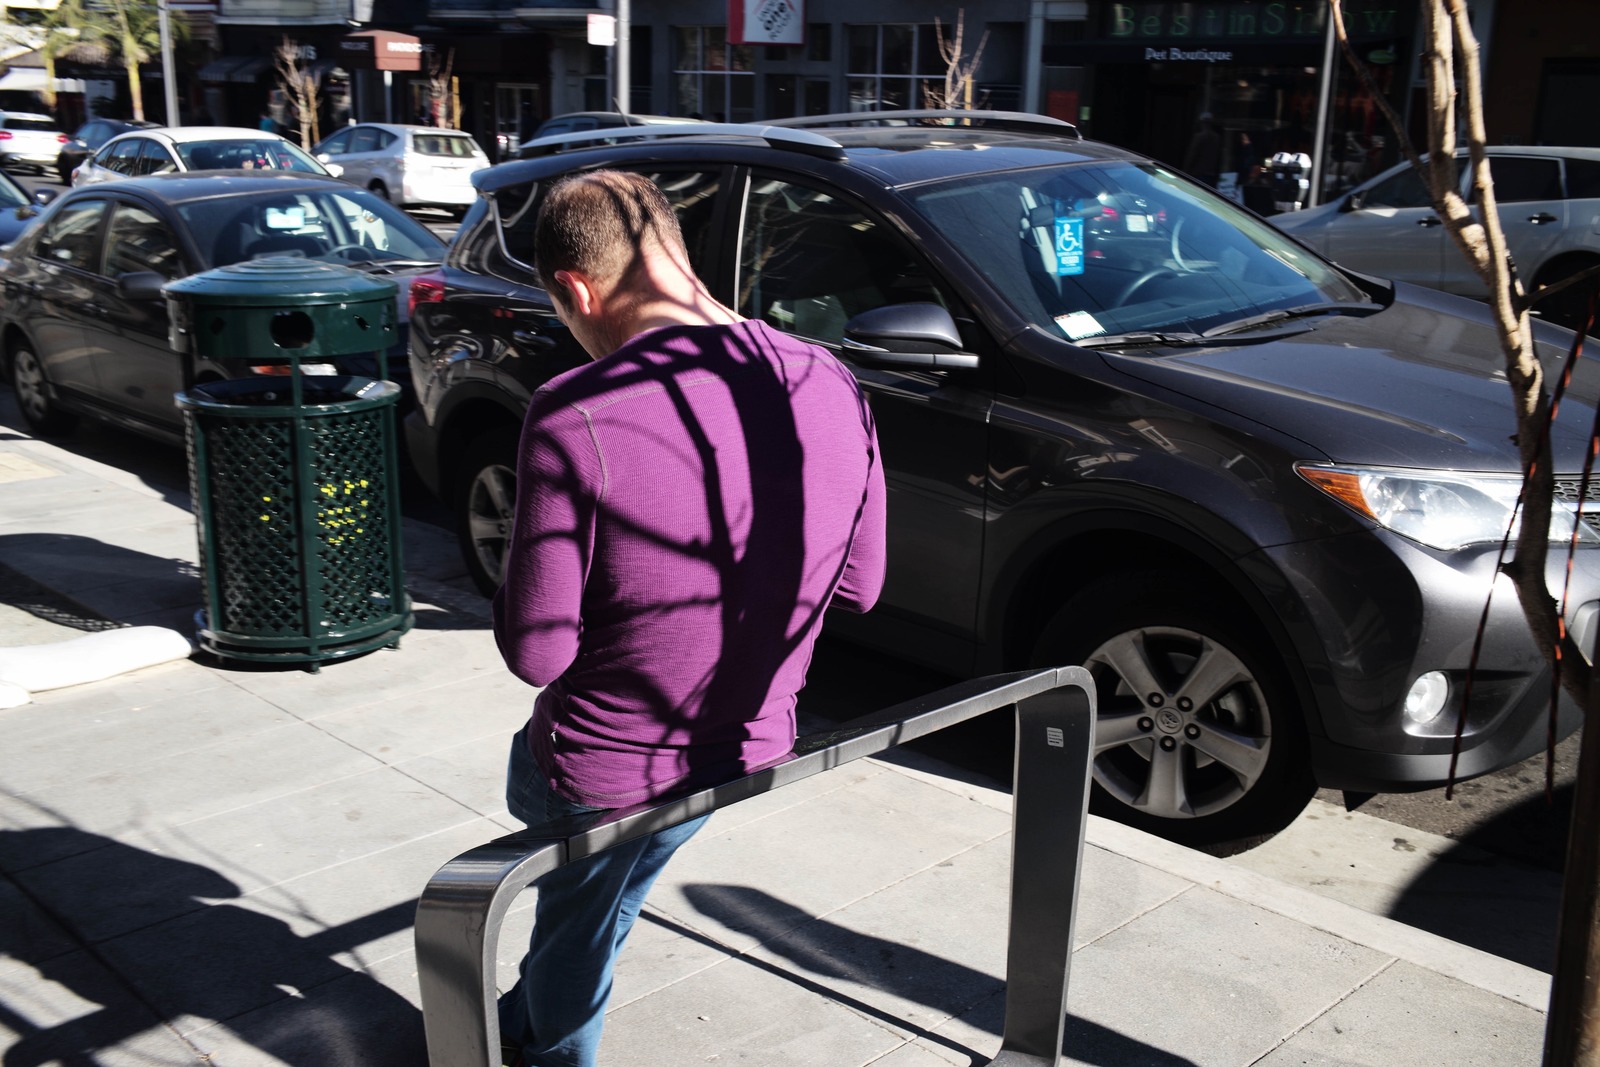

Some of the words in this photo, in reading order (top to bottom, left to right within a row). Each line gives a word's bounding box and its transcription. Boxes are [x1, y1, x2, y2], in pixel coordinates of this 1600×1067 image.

[1111, 6, 1222, 36] Best
[1228, 9, 1256, 35] in
[1145, 48, 1167, 60] Pet
[1169, 48, 1233, 62] Boutique
